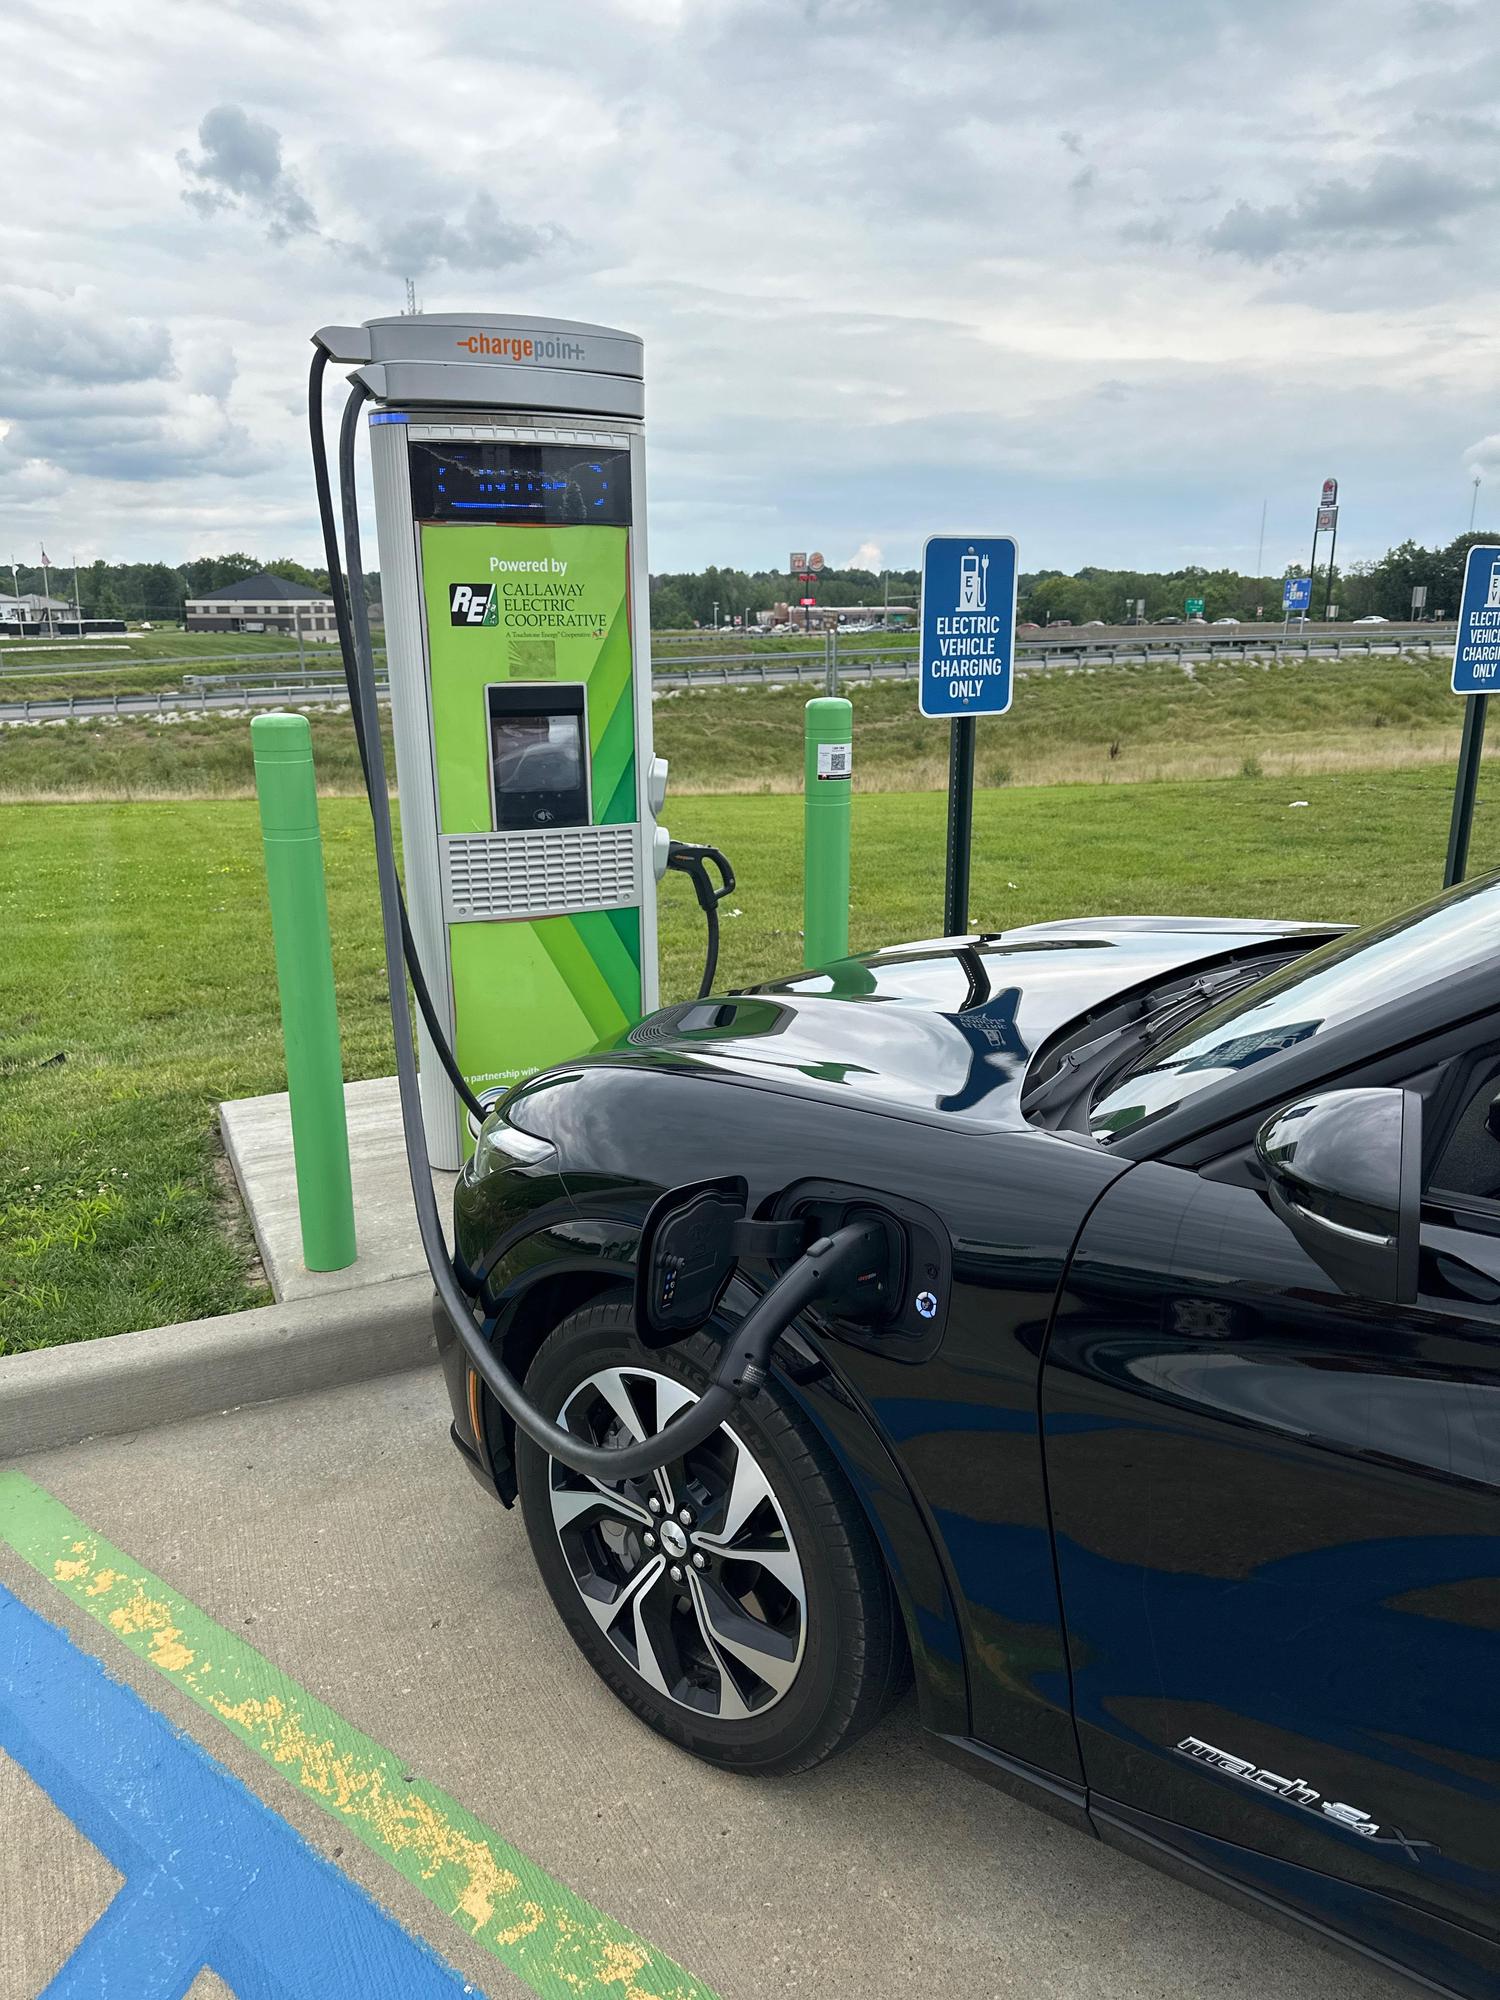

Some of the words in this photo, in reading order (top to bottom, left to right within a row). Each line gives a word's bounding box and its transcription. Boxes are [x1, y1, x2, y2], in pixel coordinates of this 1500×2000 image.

[457, 332, 585, 361] chargepoint
[490, 557, 549, 572] Powered
[551, 558, 568, 576] by
[503, 583, 585, 596] CALLAWAY
[504, 599, 575, 611] ELECTRIC
[504, 614, 607, 627] COOPERATIVE
[937, 616, 1000, 635] ELECTRIC
[939, 637, 995, 656] VEHICLE
[931, 658, 1002, 678] CHARGING
[1472, 663, 1497, 678] ONLY
[949, 680, 983, 698] ONLY
[471, 1069, 519, 1085] partnership
